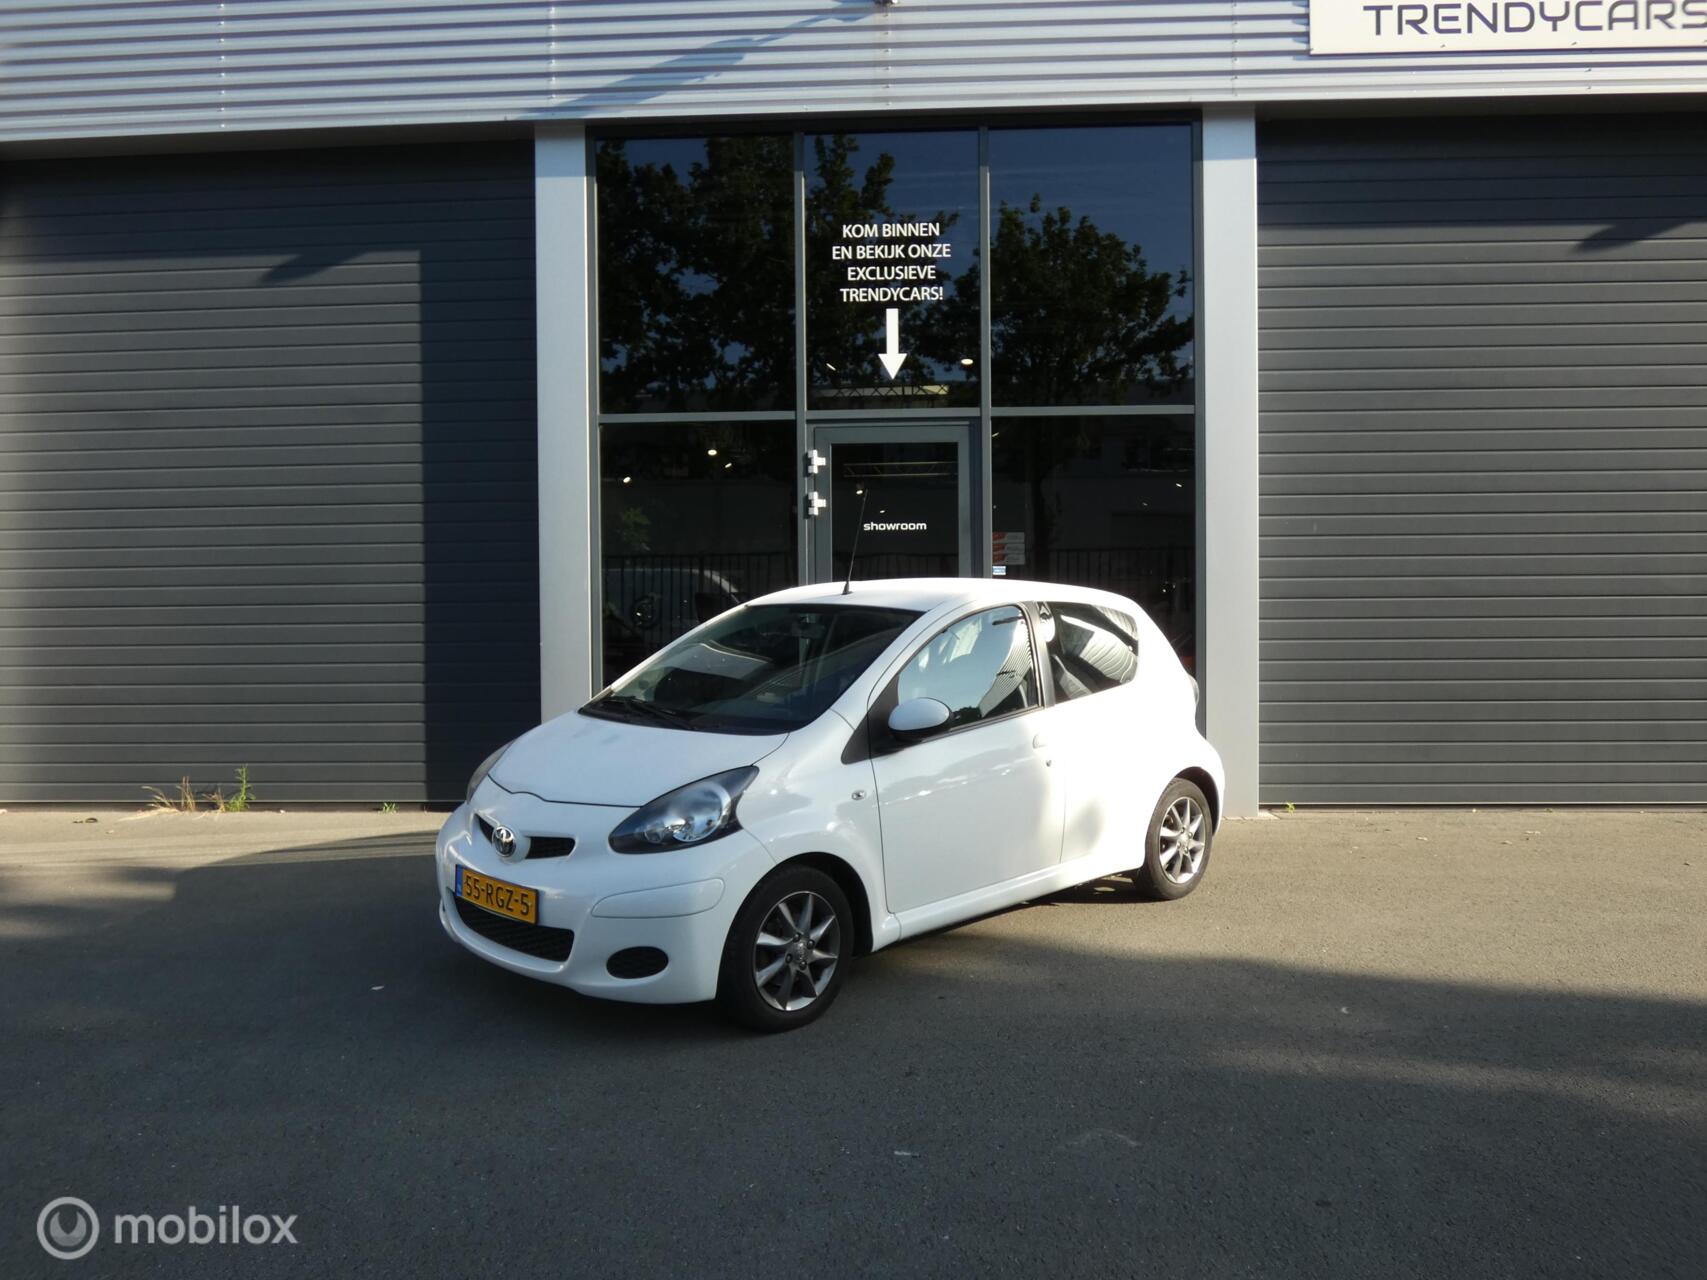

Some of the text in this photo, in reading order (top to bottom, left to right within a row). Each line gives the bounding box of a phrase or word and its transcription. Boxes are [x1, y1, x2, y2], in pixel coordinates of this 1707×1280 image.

[1363, 0, 1707, 35] TRENDYCARS
[842, 223, 940, 238] KOM BINNEN
[832, 244, 951, 260] EN BEKIJK ONZE
[847, 265, 936, 280] EXCLUSIEVE
[840, 287, 943, 302] TRENDYCARS!
[863, 522, 927, 531] showroom
[465, 875, 529, 916] 55-RGZ-5
